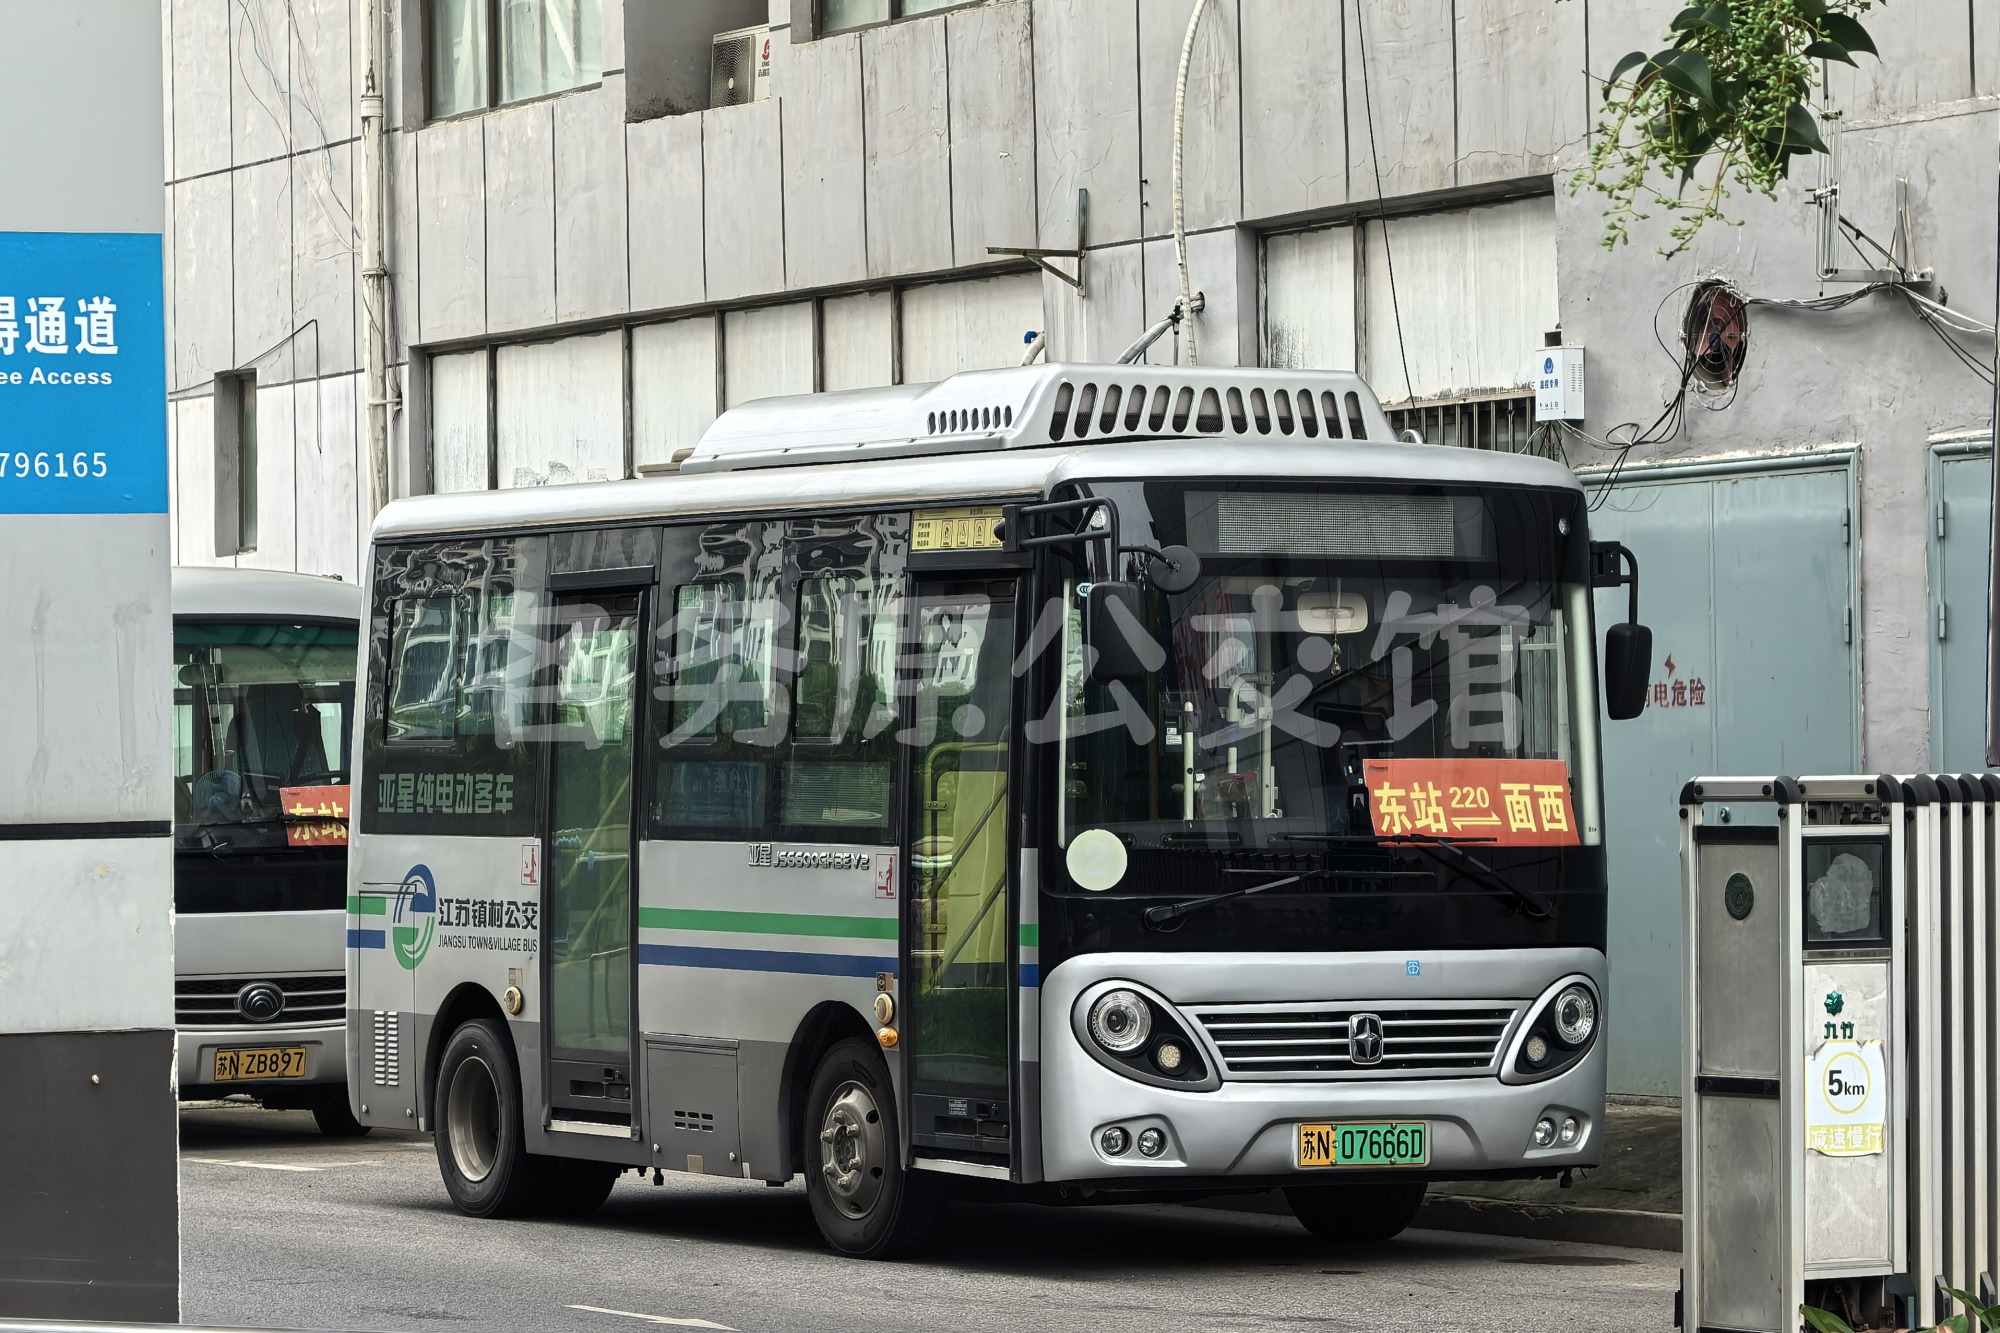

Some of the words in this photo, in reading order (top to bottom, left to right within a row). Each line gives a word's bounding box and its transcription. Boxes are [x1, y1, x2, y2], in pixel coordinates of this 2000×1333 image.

[29, 366, 113, 385] Access
[1645, 677, 1706, 708] 电危险
[377, 772, 514, 815] 亚星纯电动客车
[288, 801, 347, 841] 东站
[1373, 781, 1449, 834] 东站
[1449, 787, 1490, 808] 220
[1500, 783, 1569, 833] 面西
[748, 843, 772, 867] 亚星
[438, 897, 538, 930] 江苏镇村公交
[438, 934, 467, 949] JIANGSU
[468, 936, 521, 952] TOWN&VILLAGE
[522, 938, 538, 952] BUS
[1823, 1021, 1855, 1040] 九竹
[1828, 1069, 1865, 1096] 5km
[1810, 1126, 1882, 1149] 减速慢行
